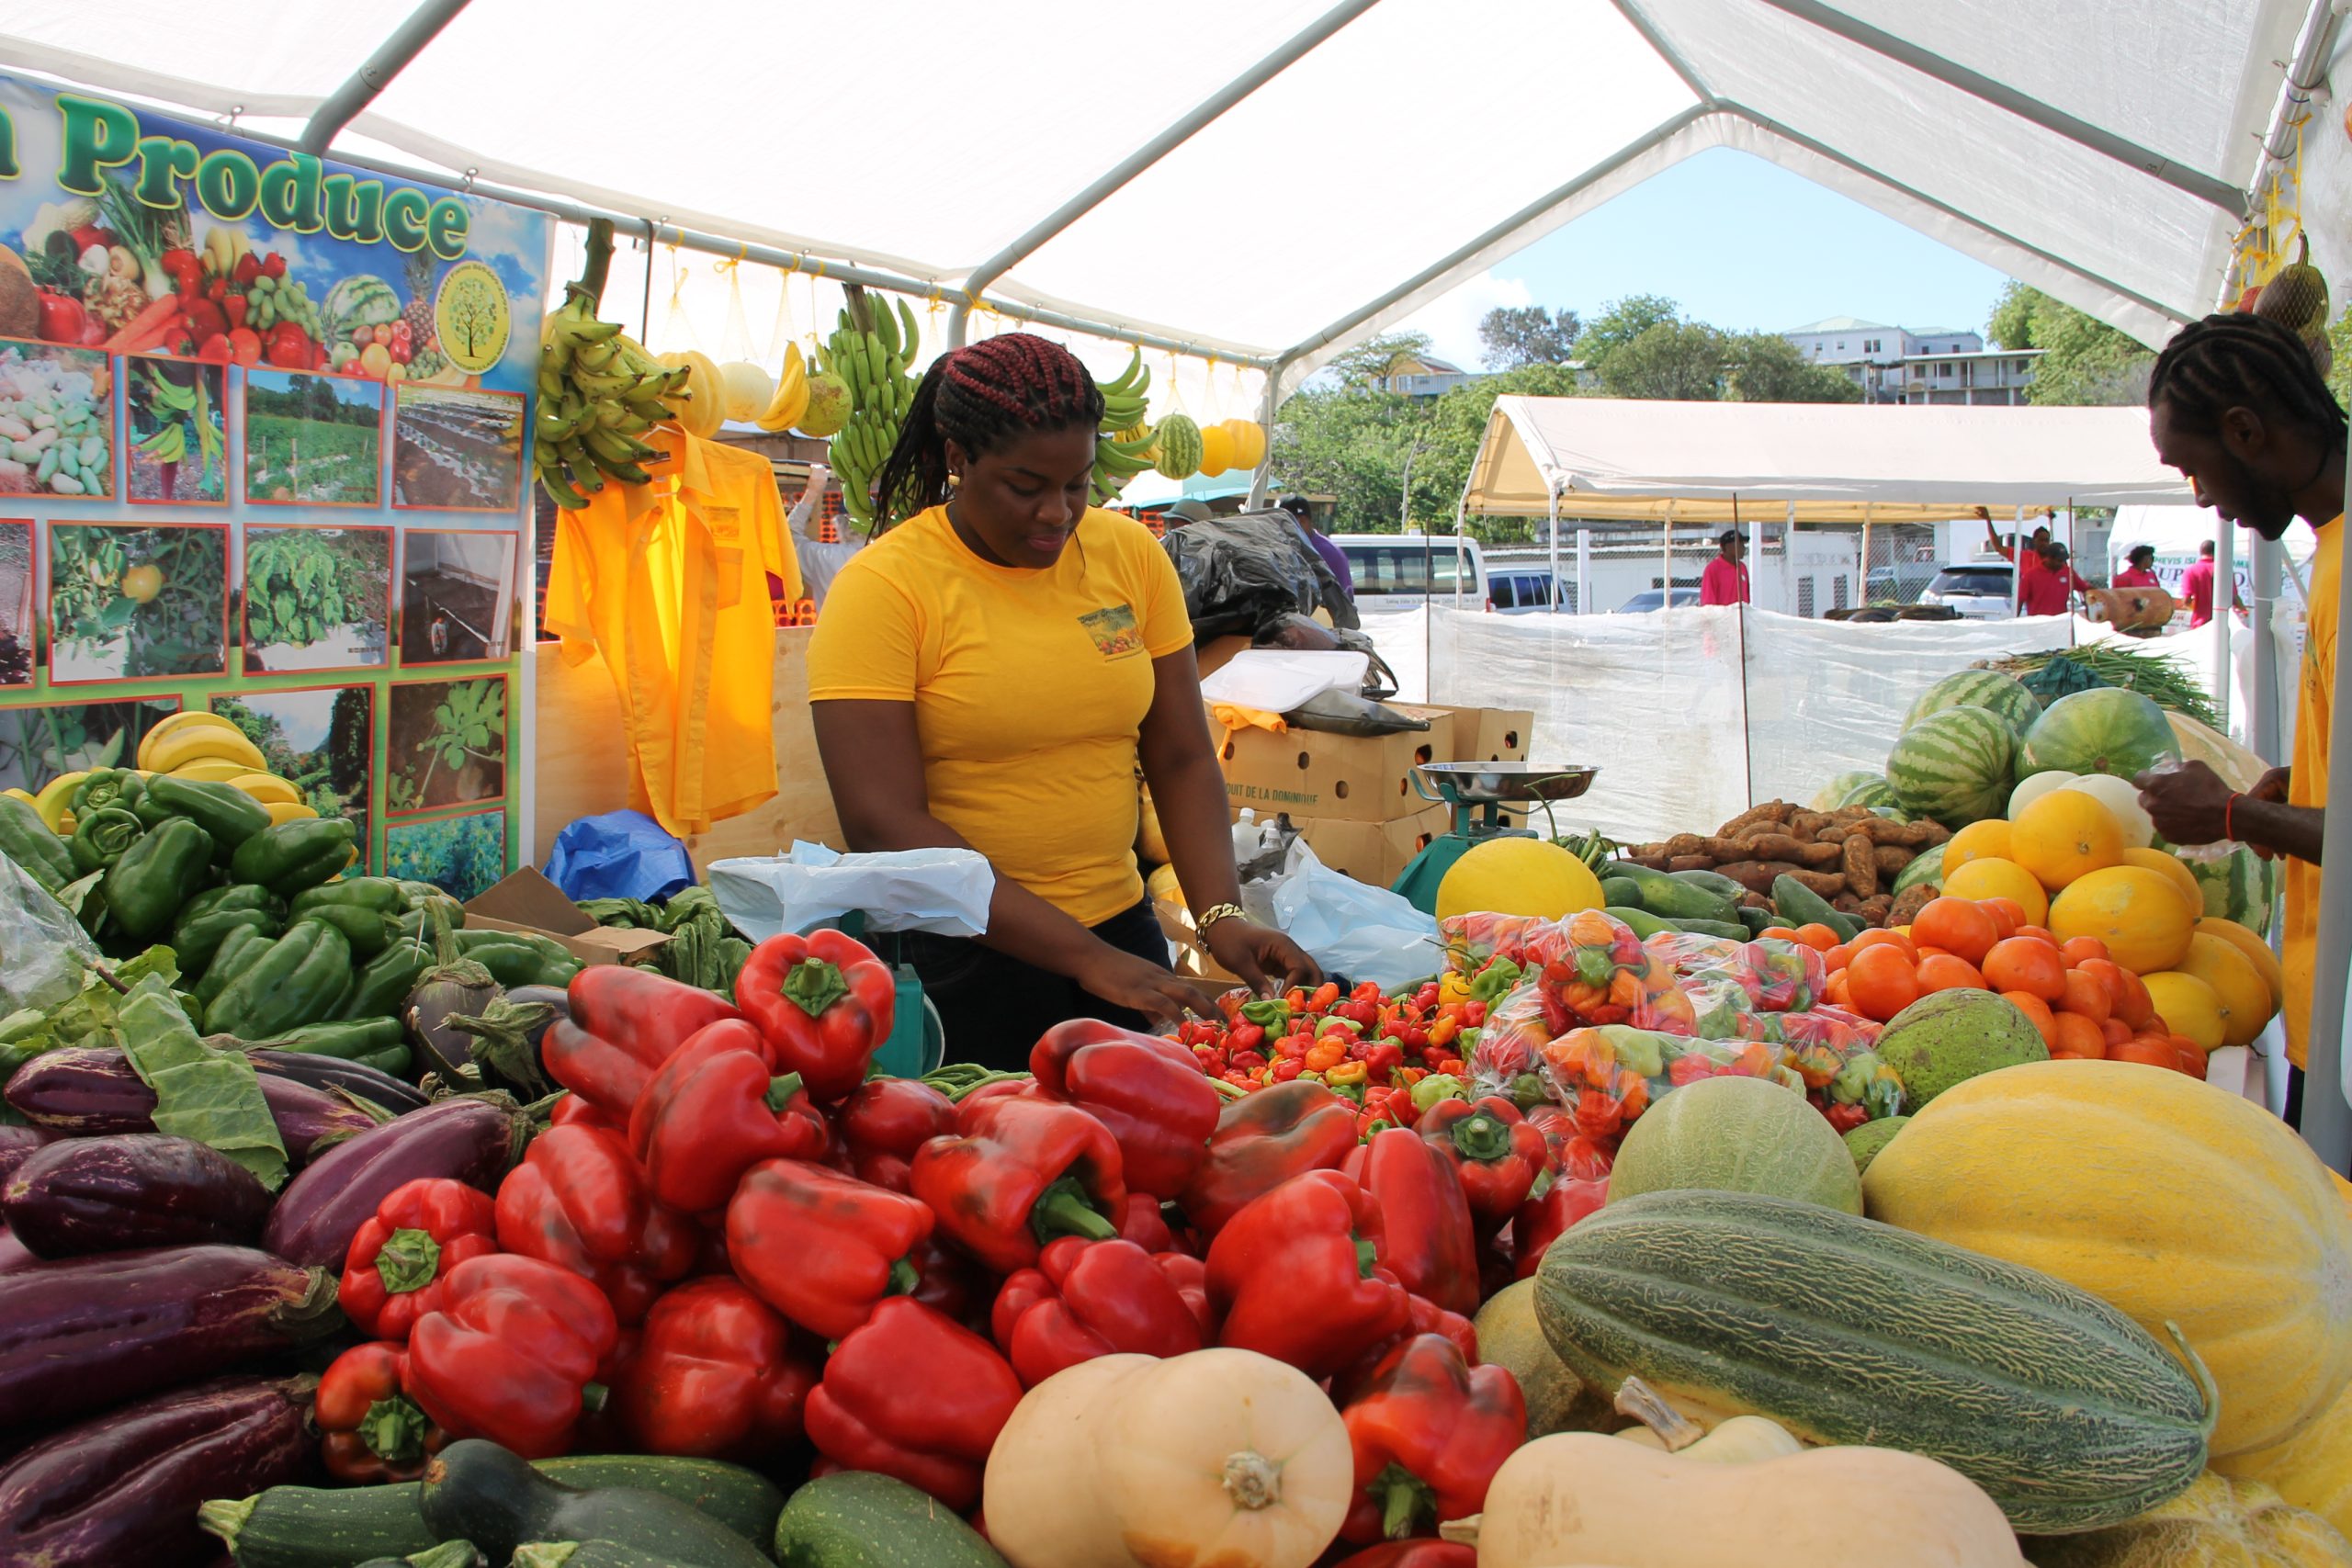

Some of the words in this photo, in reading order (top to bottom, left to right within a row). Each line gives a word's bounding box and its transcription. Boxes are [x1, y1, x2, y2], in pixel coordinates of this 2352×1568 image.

[56, 93, 470, 261] Produce
[1246, 785, 1257, 799] DE
[1259, 787, 1270, 801] LA
